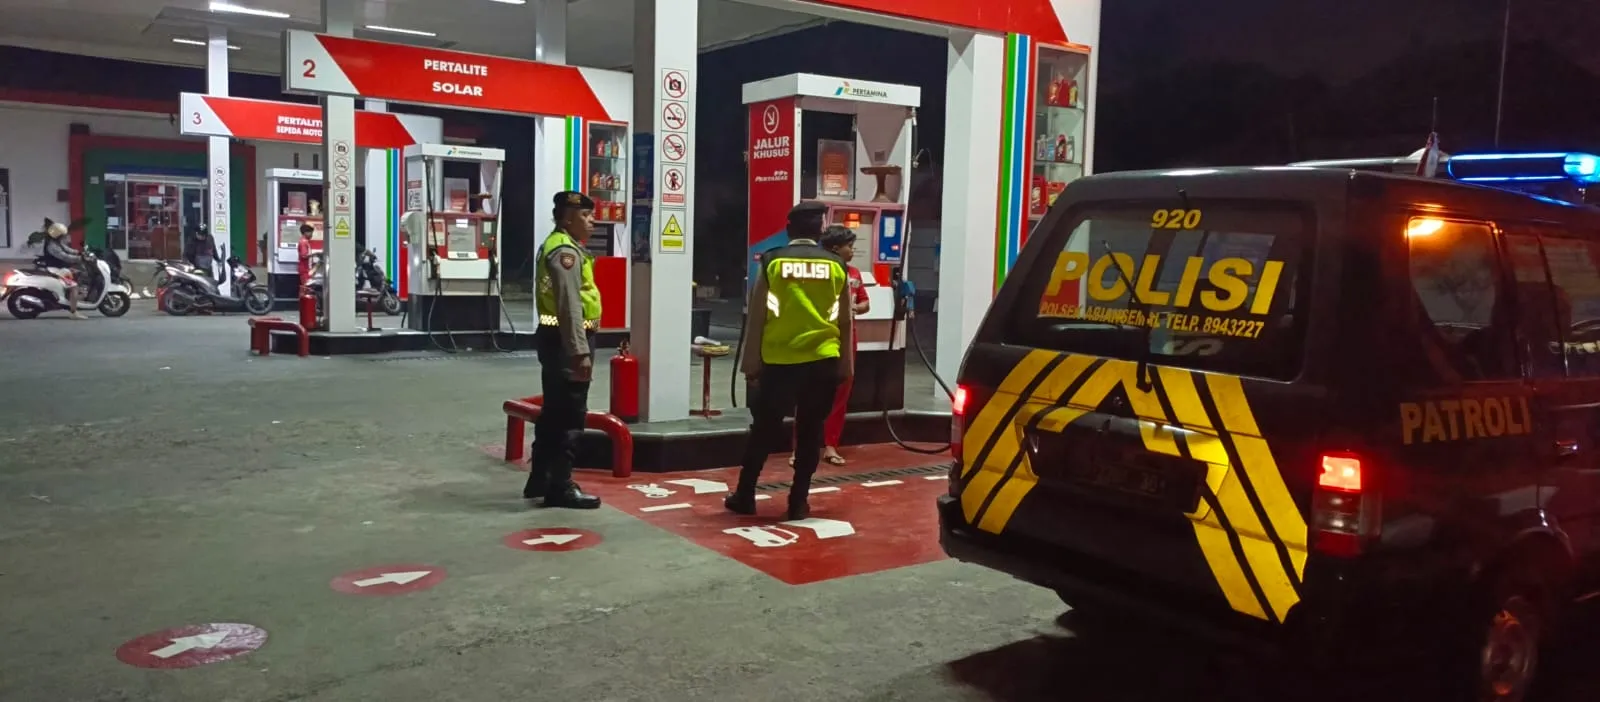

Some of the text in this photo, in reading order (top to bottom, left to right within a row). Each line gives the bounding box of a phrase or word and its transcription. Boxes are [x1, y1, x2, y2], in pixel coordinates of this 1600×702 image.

[303, 59, 316, 78] 2
[424, 59, 488, 76] PERTALITE
[432, 81, 483, 97] SOLAR
[852, 87, 888, 98] PERTAMINA
[192, 112, 202, 125] 3
[277, 115, 323, 128] PERTALIT
[276, 125, 323, 137] SEPEDA MOTO
[753, 136, 790, 150] JALUR
[753, 148, 790, 160] KHUSUS
[1151, 208, 1202, 229] 920
[782, 262, 830, 279] POLISI
[1045, 250, 1285, 316] POLISI
[1039, 301, 1084, 319] POLSEK
[1165, 313, 1199, 333] TELP.
[1203, 317, 1265, 339] 8943227
[1400, 396, 1532, 446] PATROLI
